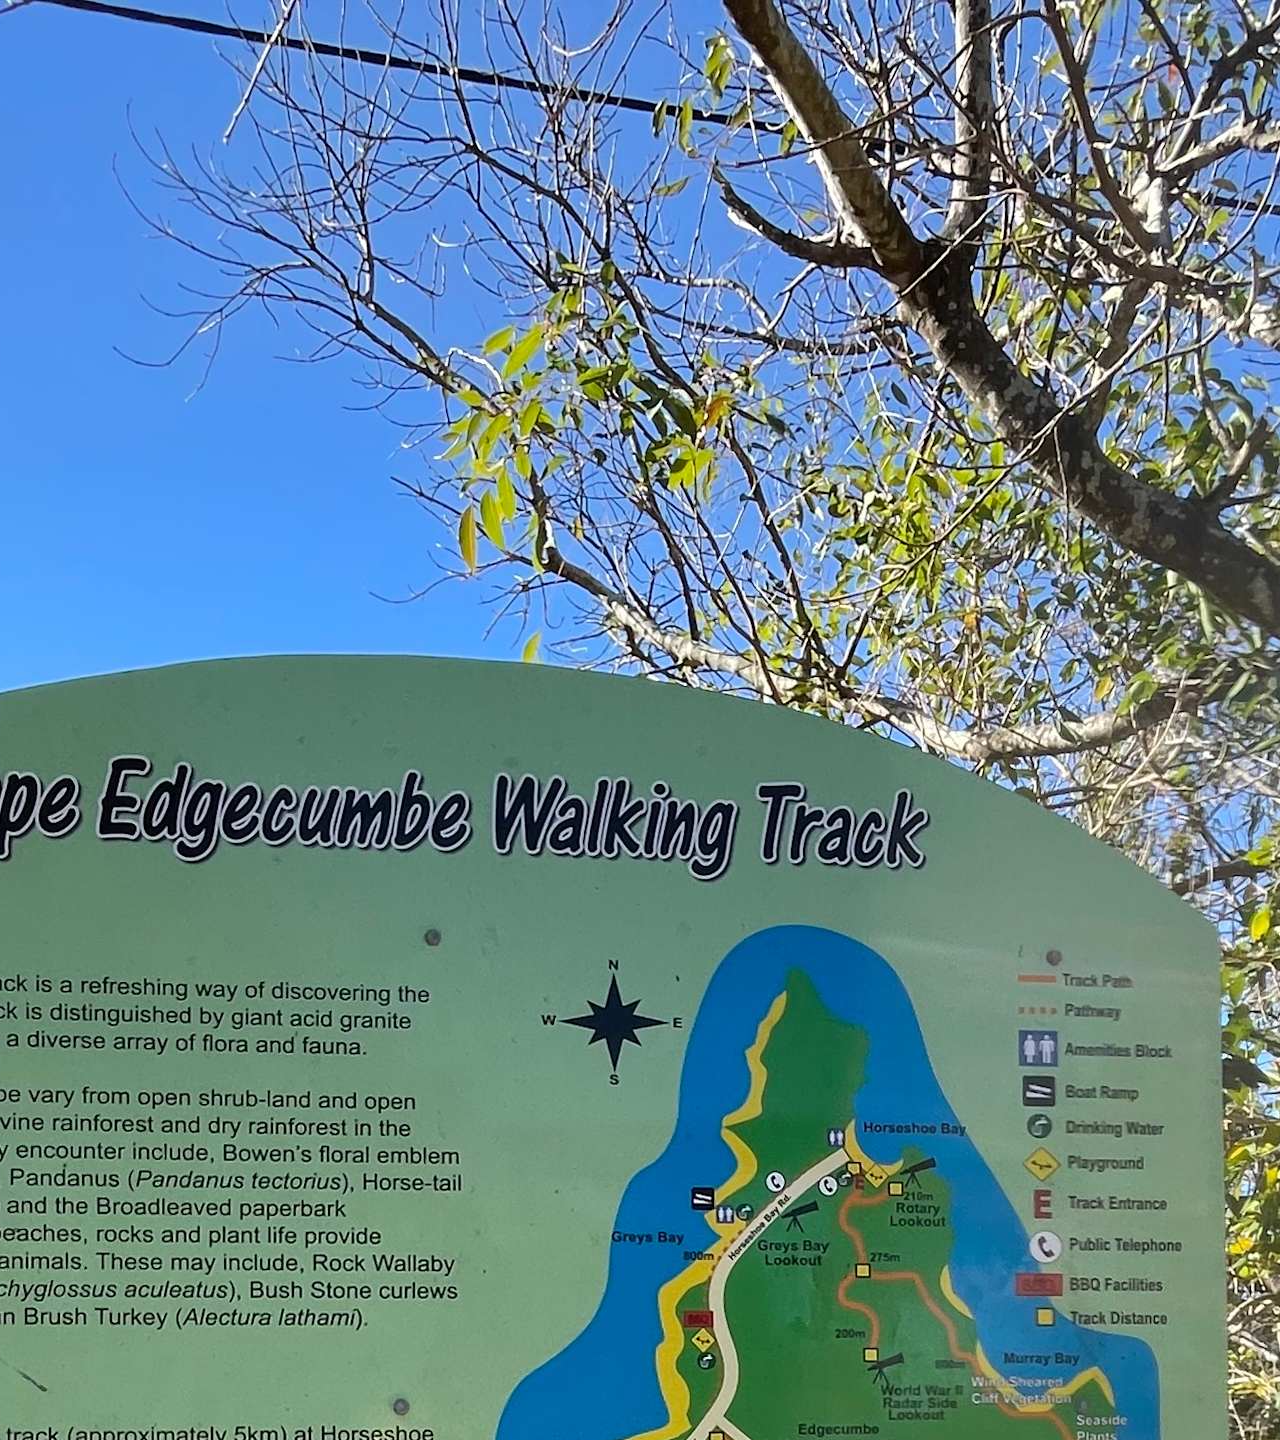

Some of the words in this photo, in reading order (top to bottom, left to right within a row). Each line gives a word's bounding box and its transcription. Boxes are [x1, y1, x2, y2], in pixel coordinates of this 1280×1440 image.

[96, 755, 472, 864] Edgecumbe
[492, 774, 739, 881] Walking
[756, 783, 927, 871] Track
[608, 960, 618, 970] N
[36, 975, 52, 992] is
[60, 980, 72, 993] a
[81, 977, 187, 1001] refreshing
[195, 984, 238, 1002] way
[245, 981, 264, 998] of
[272, 982, 390, 1006] discovering
[398, 986, 429, 1003] the
[541, 1015, 556, 1025] W
[673, 1018, 682, 1028] E
[610, 1074, 619, 1085] S
[1066, 1086, 1097, 1099] Boat
[1102, 1087, 1138, 1102] Ramp
[864, 1122, 937, 1134] Horseshoe
[941, 1123, 966, 1137] Bay
[1066, 1121, 1122, 1137] Drinking
[1127, 1122, 1164, 1136] Water
[1068, 1156, 1144, 1172] Playground
[10, 1166, 119, 1187] Pandanus
[128, 1169, 244, 1192] (Pandanus
[252, 1172, 354, 1195] tectorius),
[363, 1173, 461, 1191] Horse-tail
[896, 1202, 940, 1218] Rotary
[1069, 1196, 1104, 1210] Track
[1110, 1198, 1167, 1211] Entrance
[890, 1215, 945, 1227] Lookout
[612, 1231, 653, 1244] Greys
[658, 1232, 684, 1246] Bay
[1070, 1238, 1111, 1252] Public
[1116, 1238, 1181, 1253] Telephone
[758, 1240, 799, 1255] Greys
[803, 1240, 829, 1254] Bay
[765, 1254, 822, 1266] Lookout
[1070, 1279, 1101, 1293] BBQ
[1105, 1278, 1163, 1292] Facilities
[1070, 1311, 1107, 1325] Track
[1111, 1312, 1167, 1325] Distance
[1004, 1352, 1051, 1366] Murray
[1055, 1353, 1079, 1366] Bay
[798, 1424, 879, 1437] Edgecumbe
